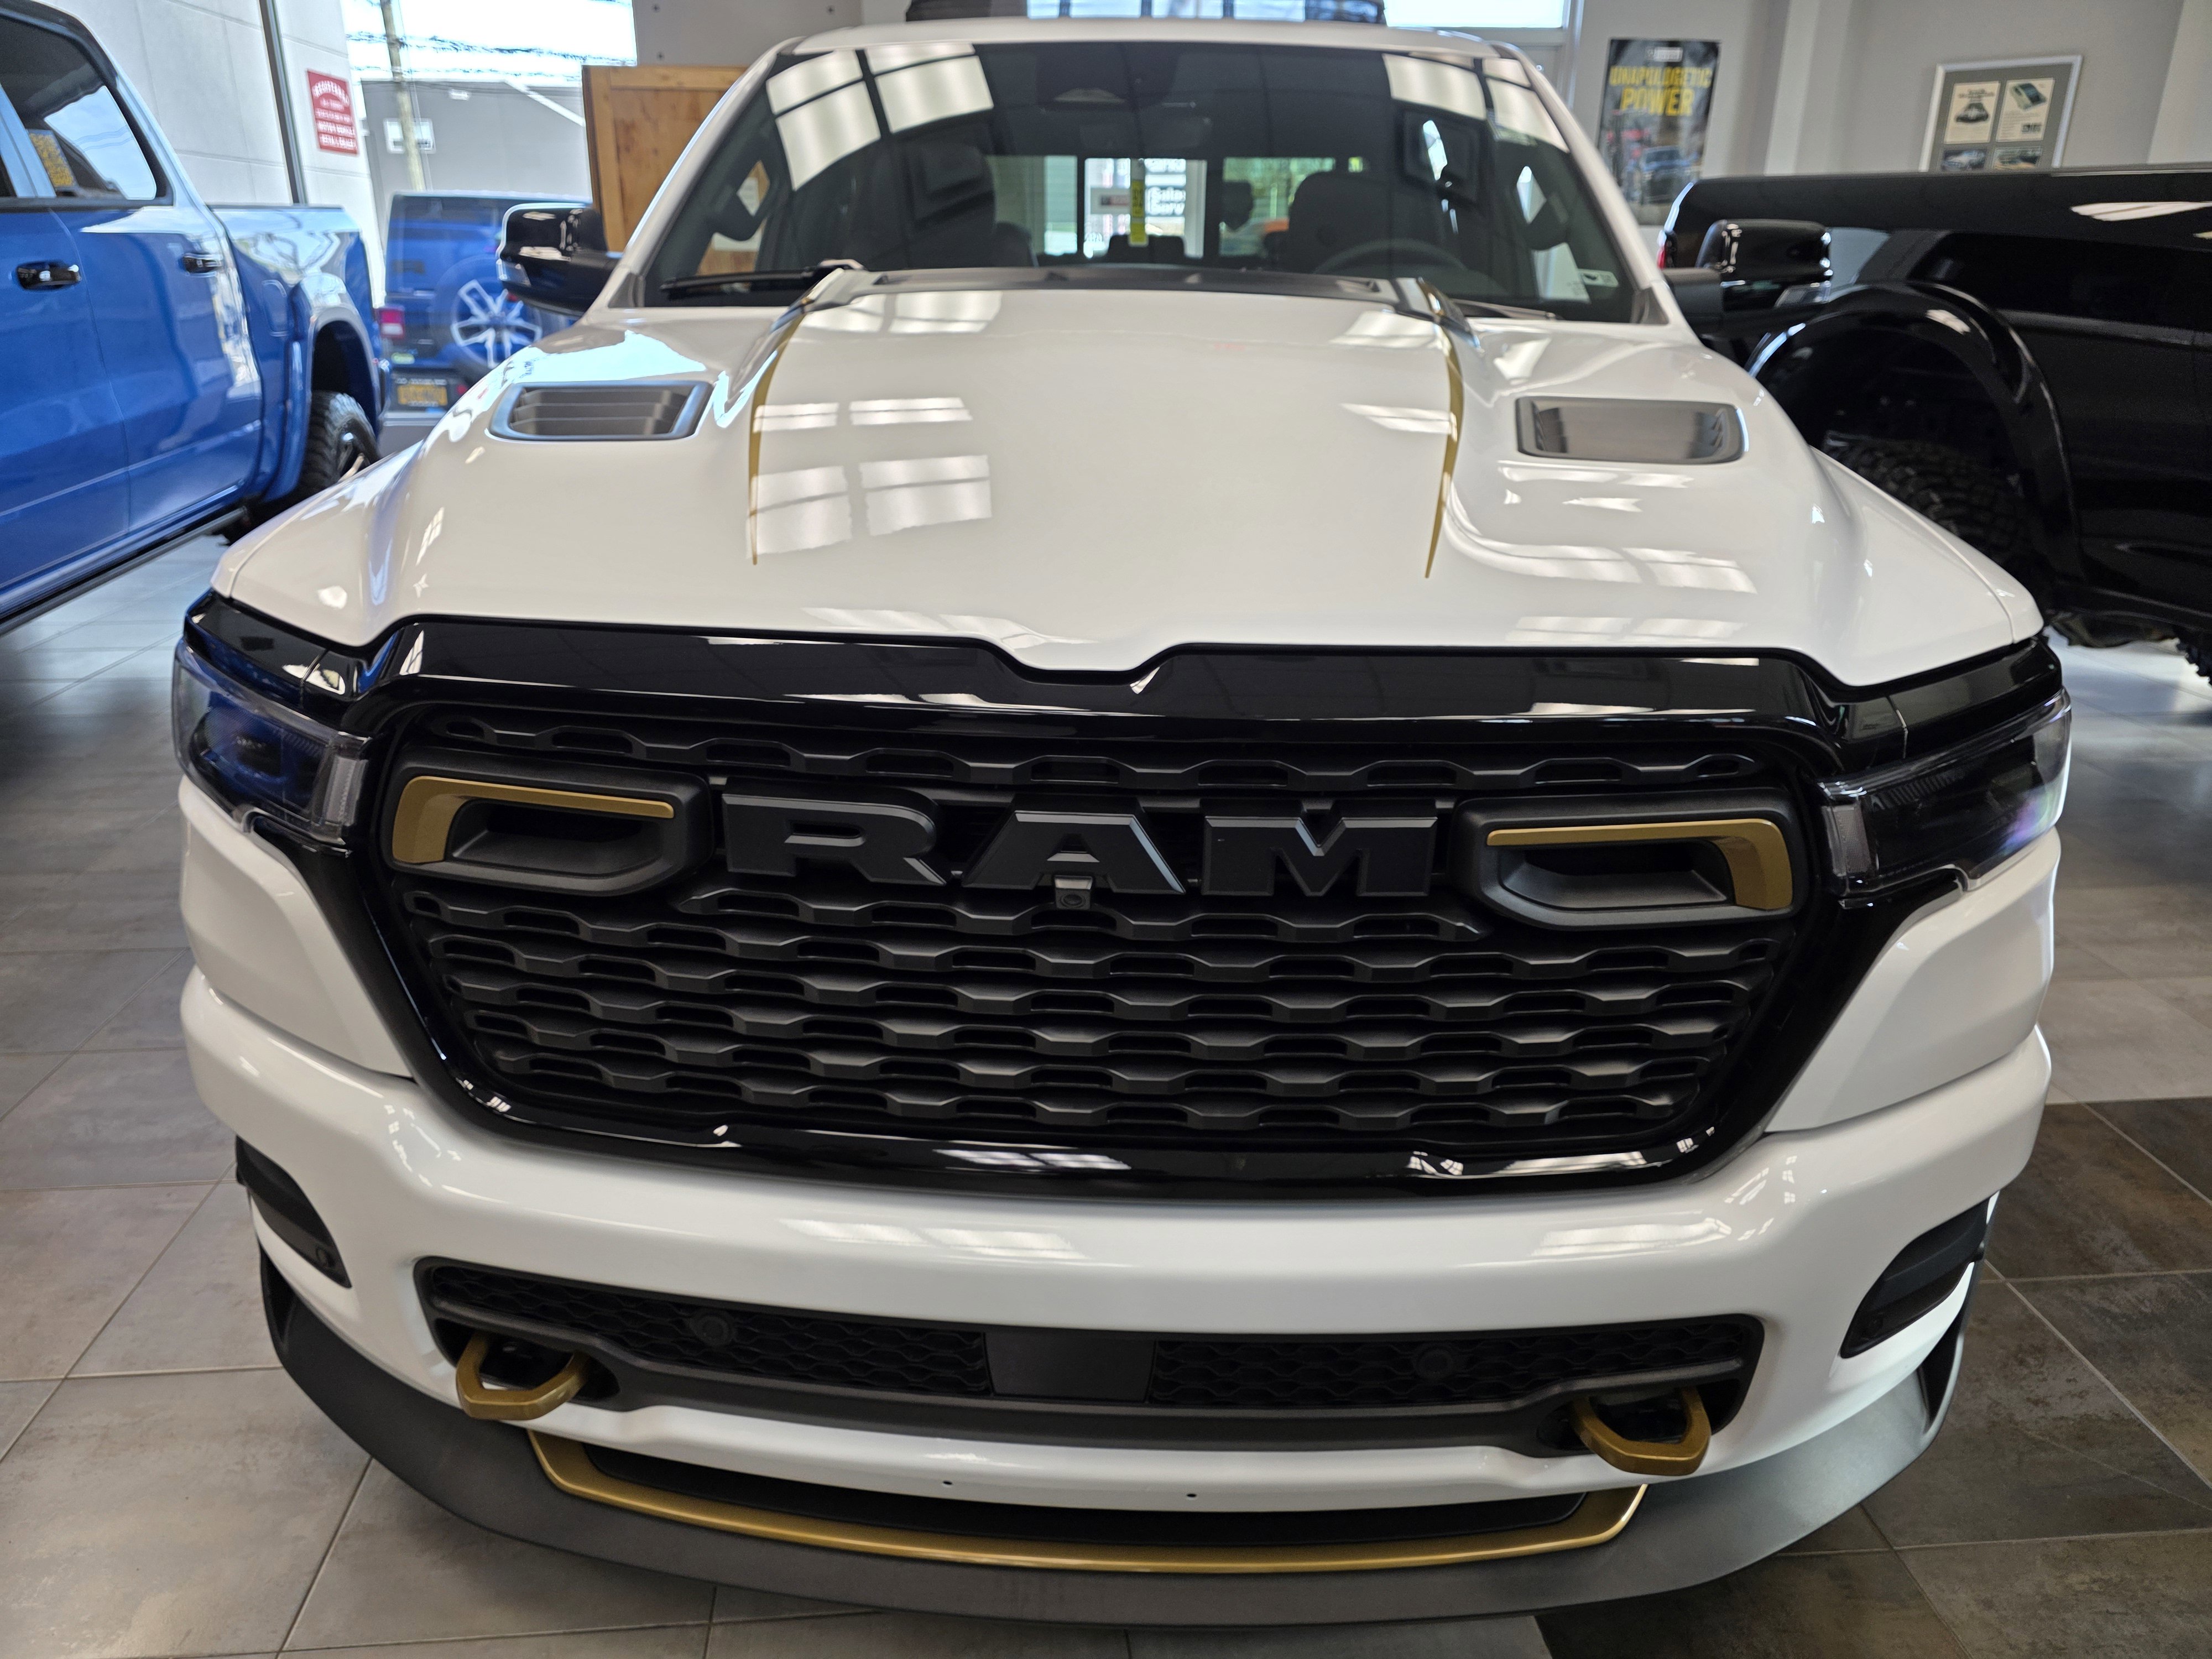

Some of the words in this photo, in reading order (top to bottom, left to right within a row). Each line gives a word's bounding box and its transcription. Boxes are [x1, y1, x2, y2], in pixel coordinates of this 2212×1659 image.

[1610, 66, 1712, 88] UNAPOLOGETIC
[1621, 86, 1695, 116] POWER
[721, 787, 1438, 897] RAM
